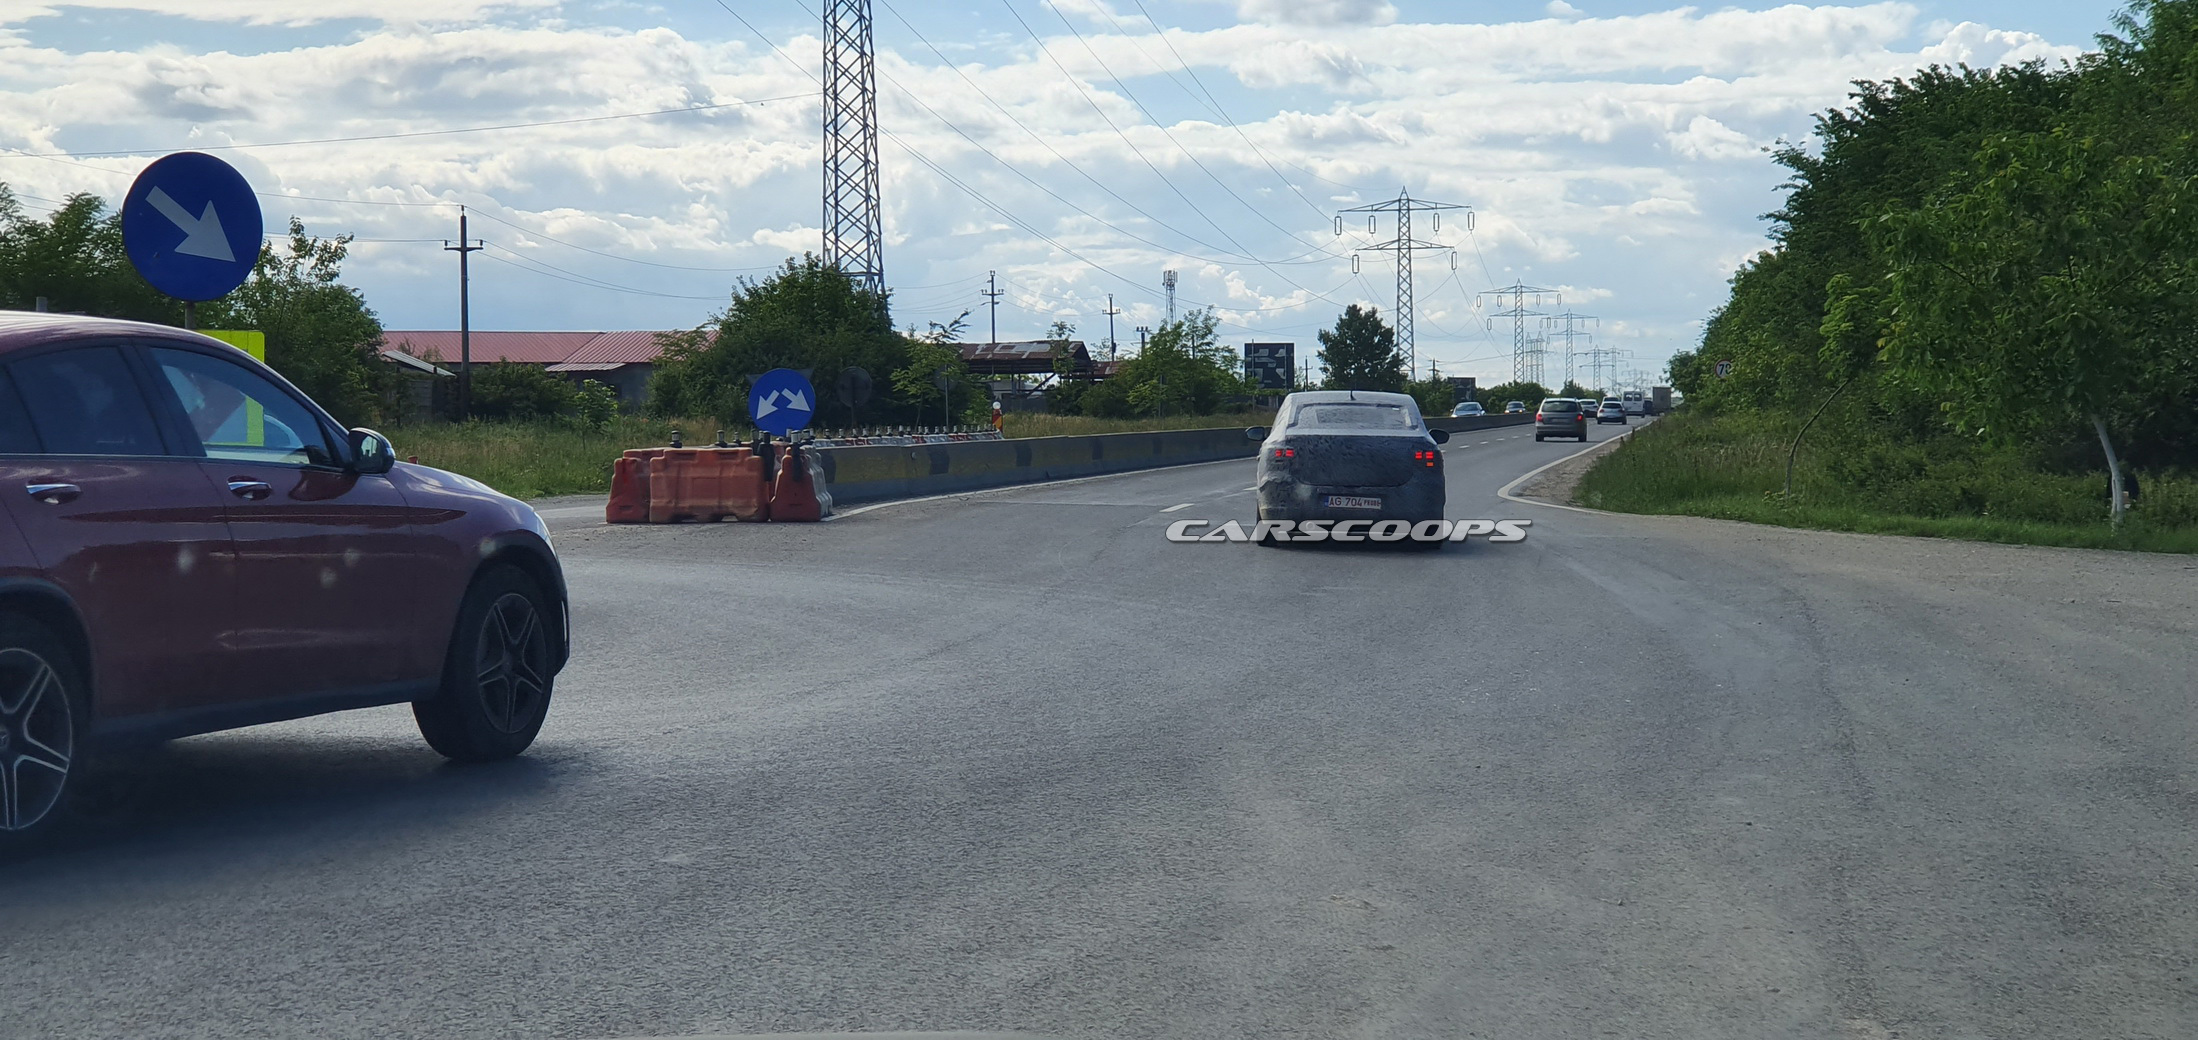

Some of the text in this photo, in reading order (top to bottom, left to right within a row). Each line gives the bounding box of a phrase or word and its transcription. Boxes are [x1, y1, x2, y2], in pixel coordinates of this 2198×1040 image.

[1718, 363, 1732, 375] 70
[1329, 496, 1342, 506] AG
[1345, 497, 1363, 507] 704
